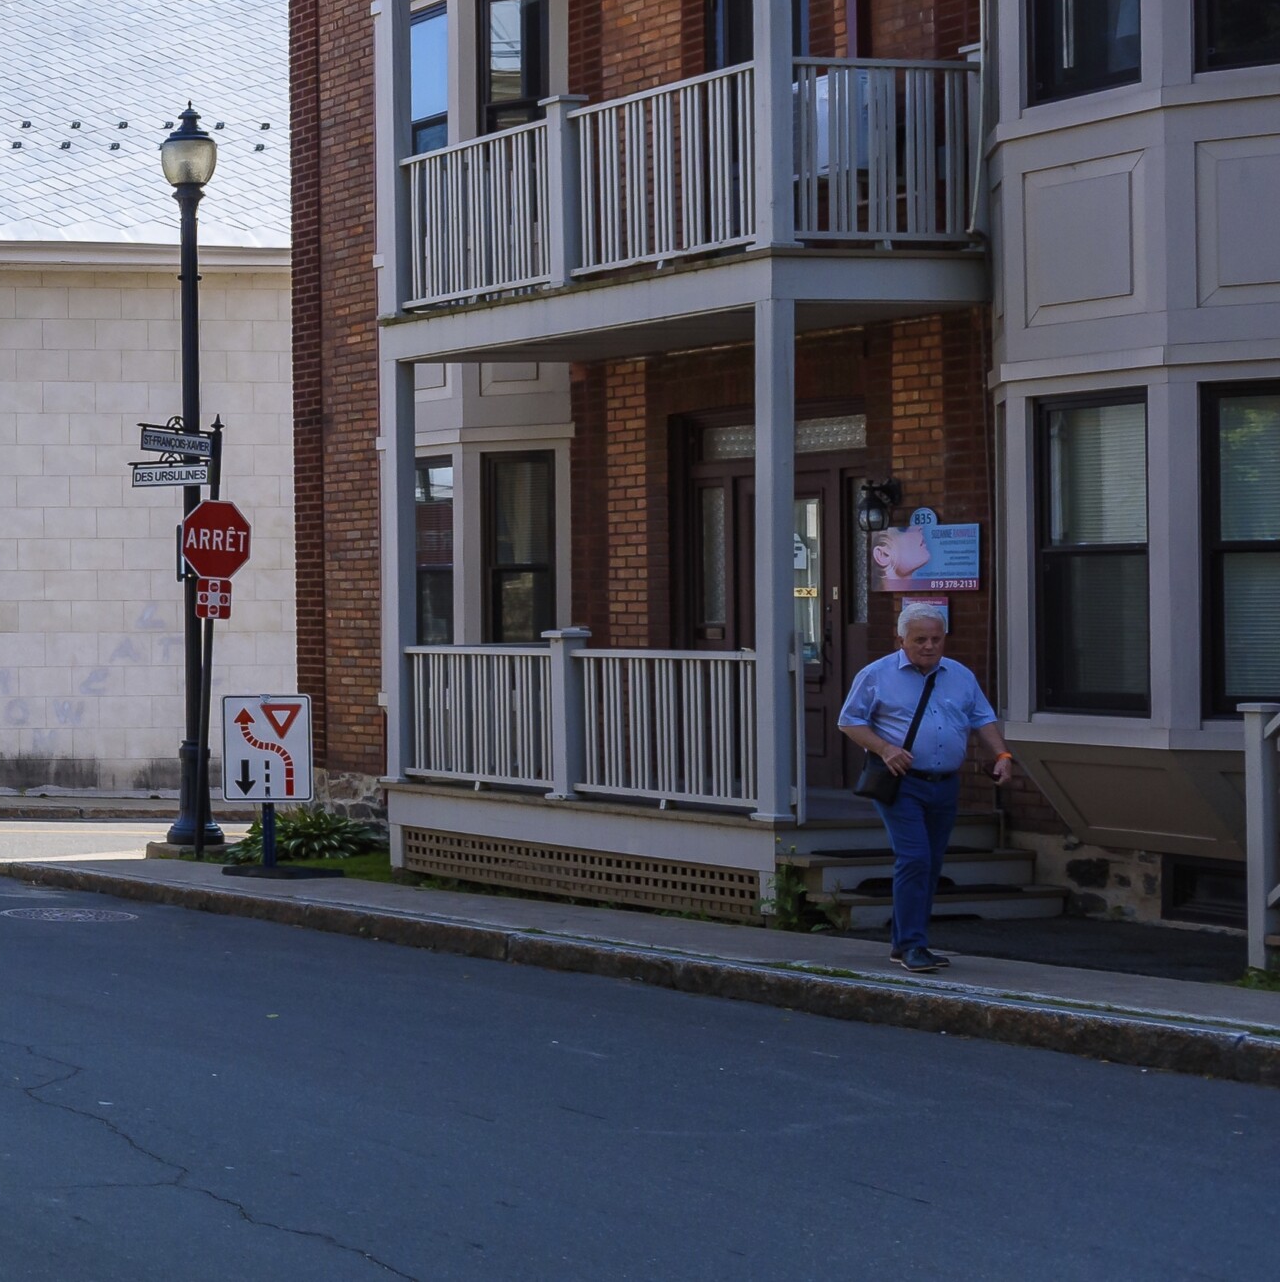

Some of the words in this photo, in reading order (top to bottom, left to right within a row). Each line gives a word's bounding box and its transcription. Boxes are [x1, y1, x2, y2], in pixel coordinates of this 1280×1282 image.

[143, 434, 210, 452] ST-FRANÇOIS-XAVIER
[135, 472, 153, 483] DES
[155, 469, 207, 482] URSULINES
[914, 514, 932, 525] 835
[185, 526, 247, 553] ARRÊT
[931, 580, 944, 589] 819
[945, 579, 977, 589] 378-2131
